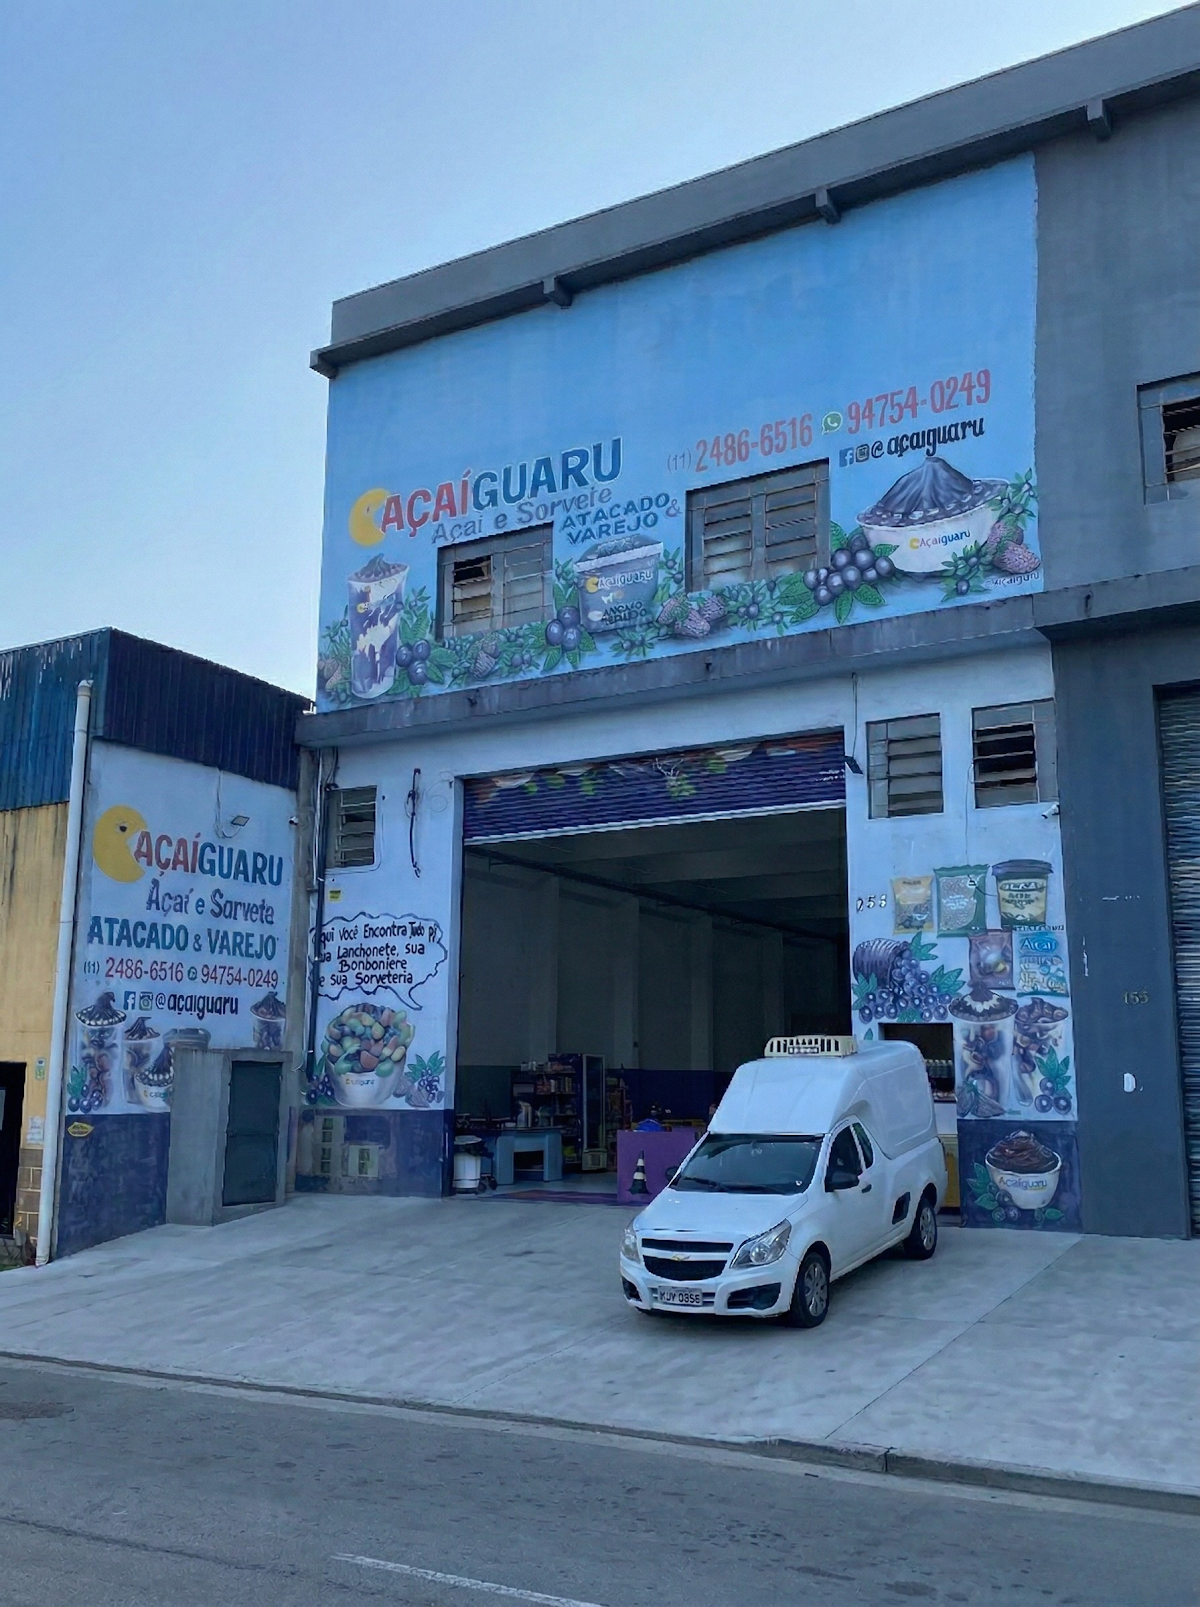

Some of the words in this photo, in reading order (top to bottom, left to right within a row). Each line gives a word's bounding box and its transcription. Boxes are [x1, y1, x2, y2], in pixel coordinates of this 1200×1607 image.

[667, 453, 692, 474] (11)
[695, 414, 813, 472] 2486-6516
[847, 369, 991, 434] 94754-0249
[380, 437, 623, 537] AÇAÍGUARU
[494, 513, 508, 529] e
[561, 492, 670, 531] ATACADO
[666, 498, 683, 518] &
[567, 512, 659, 545] VAREJO
[134, 830, 284, 887] AÇAÍGUARU
[195, 897, 205, 915] e
[87, 916, 189, 951] ATACADO
[192, 933, 202, 952] &
[207, 928, 277, 961] VAREJO
[316, 927, 335, 949] qui
[363, 921, 407, 939] Encontra
[337, 943, 399, 960] Lanchonete,
[405, 943, 425, 955] sua
[338, 957, 407, 973] Bonboniere
[83, 960, 100, 975] (11)
[105, 957, 183, 983] 2486-6516
[201, 964, 279, 989] 94754-0249
[330, 974, 347, 986] sua
[355, 970, 413, 985] Sorveteria
